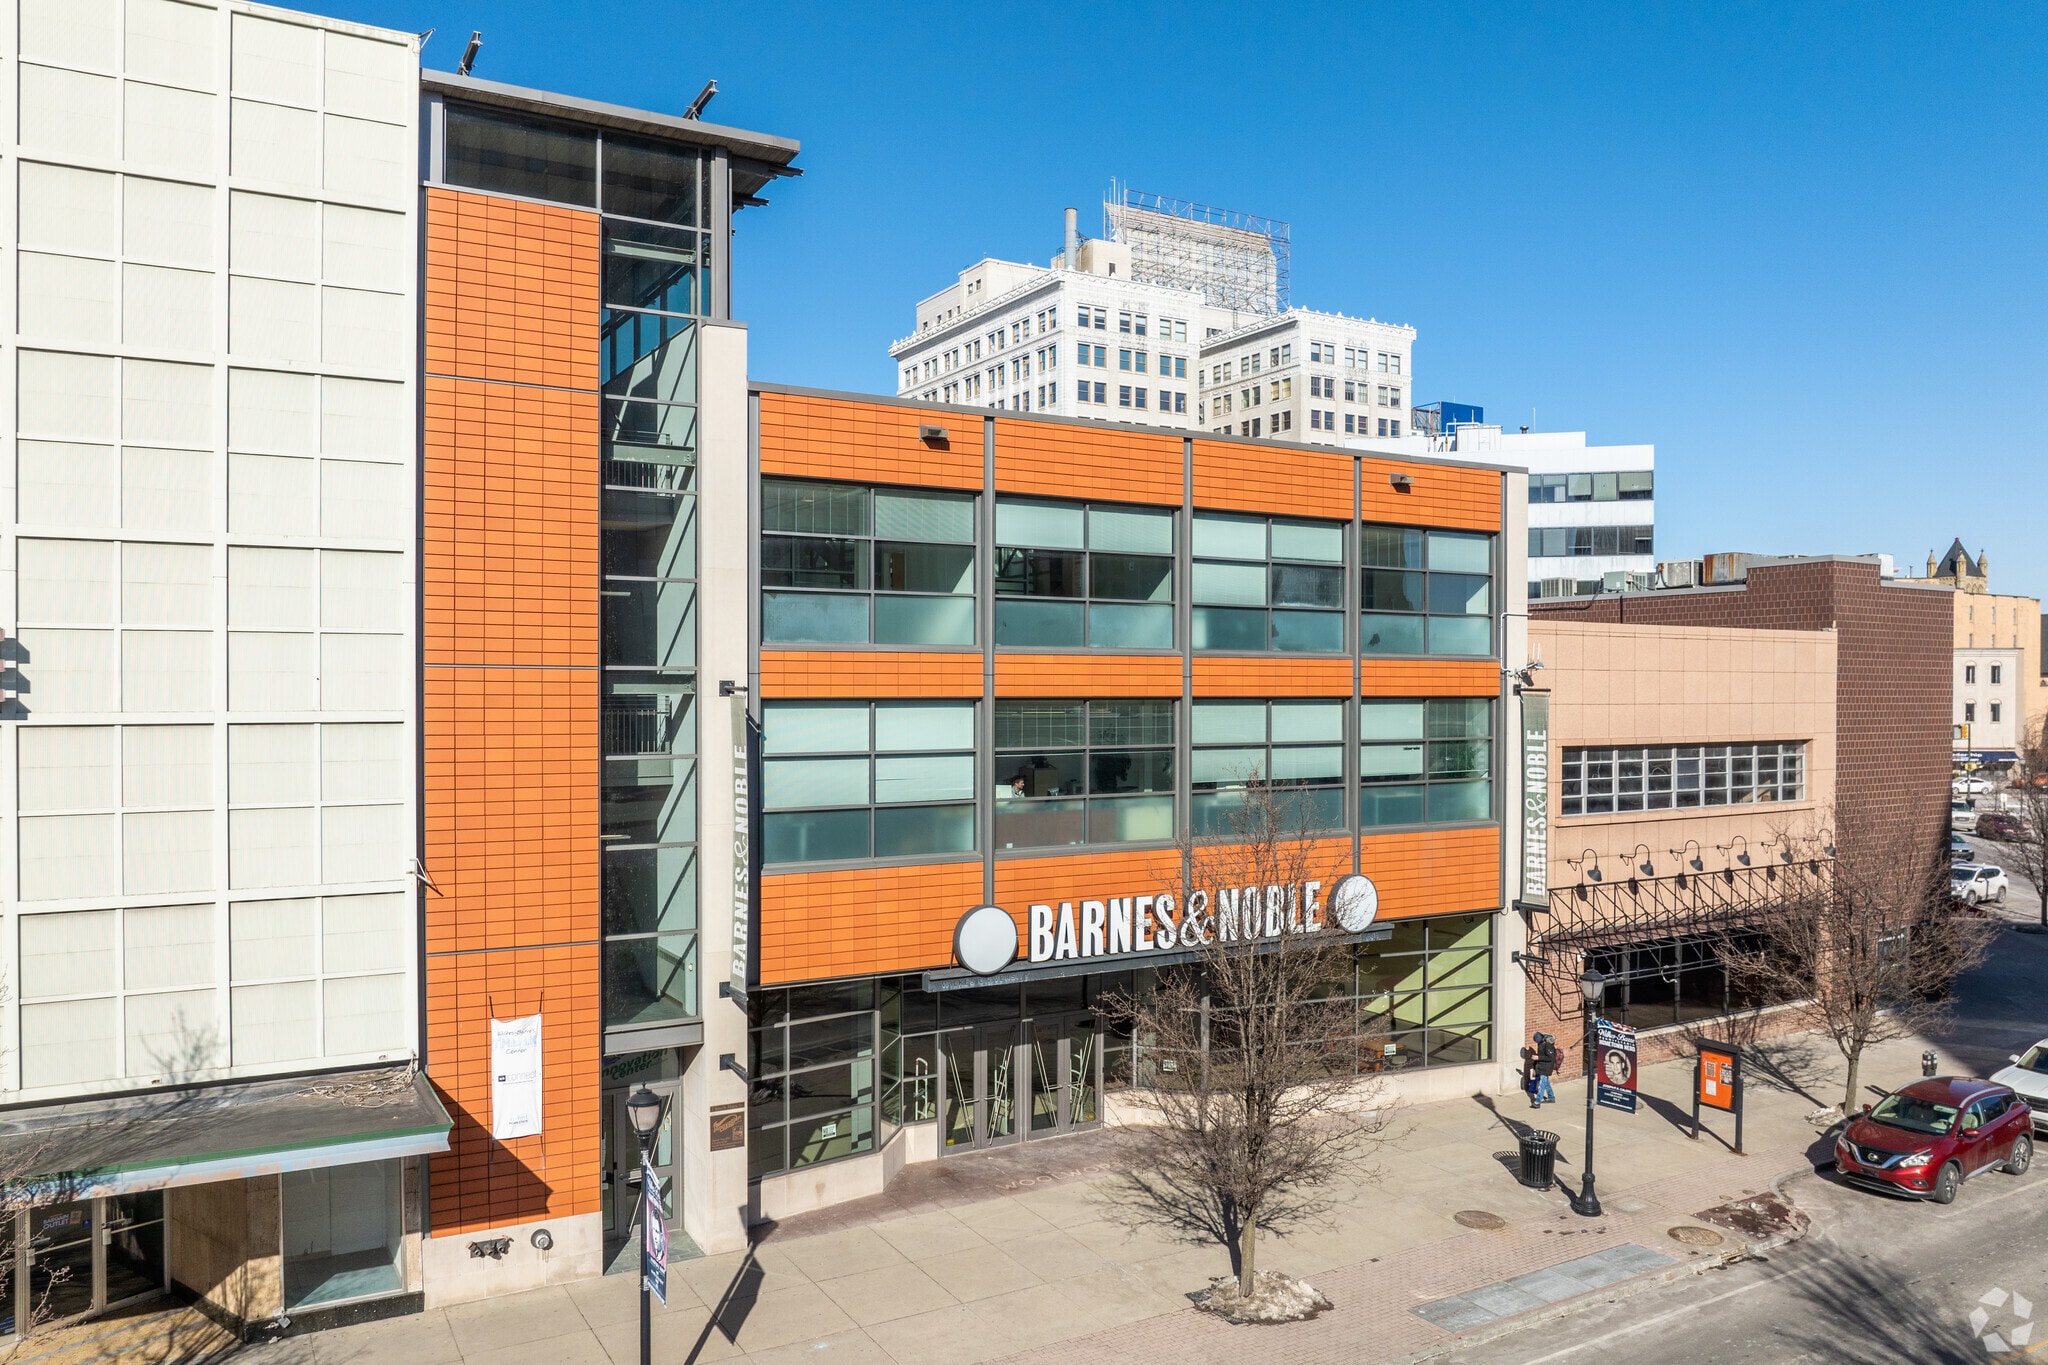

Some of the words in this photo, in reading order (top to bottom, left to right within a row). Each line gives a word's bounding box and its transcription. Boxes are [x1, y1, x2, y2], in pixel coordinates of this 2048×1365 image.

[602, 1048, 668, 1077] nnovation
[611, 1060, 652, 1081] Center
[43, 1219, 69, 1230] OUTLET
